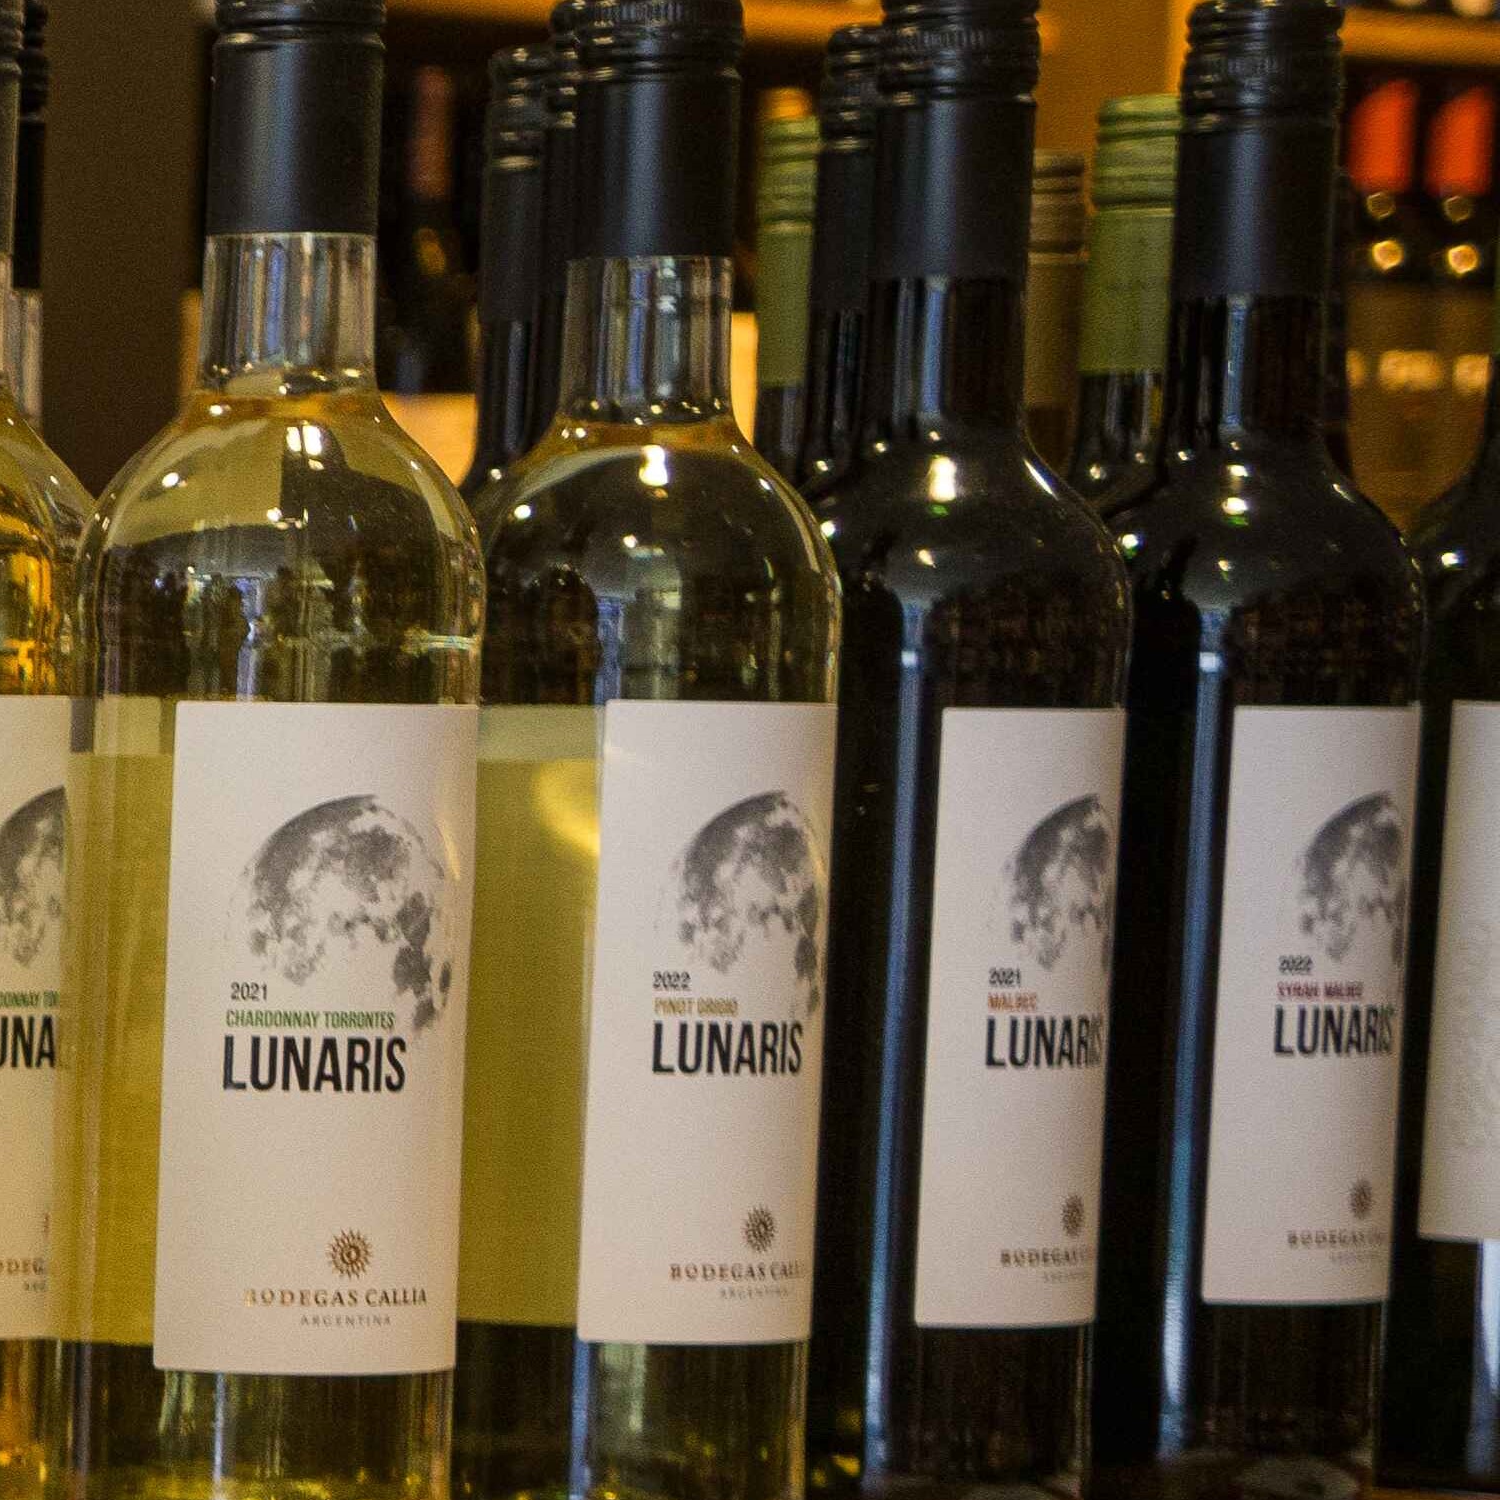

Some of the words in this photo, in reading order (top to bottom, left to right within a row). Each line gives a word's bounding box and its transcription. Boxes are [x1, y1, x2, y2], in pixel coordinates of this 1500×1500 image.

[651, 970, 692, 991] 2022
[987, 966, 1022, 986] 2021
[230, 981, 268, 1001] 2021
[653, 997, 695, 1016] PINOT
[225, 1010, 320, 1029] CHARDONNAY
[324, 1011, 397, 1030] TORRONTES
[651, 1019, 805, 1076] LUNARIS
[222, 1034, 408, 1093] LUNARIS
[668, 1262, 767, 1282] BODEGAS
[244, 1287, 360, 1308] BODEGAS
[363, 1285, 429, 1308] CALLIA
[300, 1313, 391, 1328] ARGENTINA
